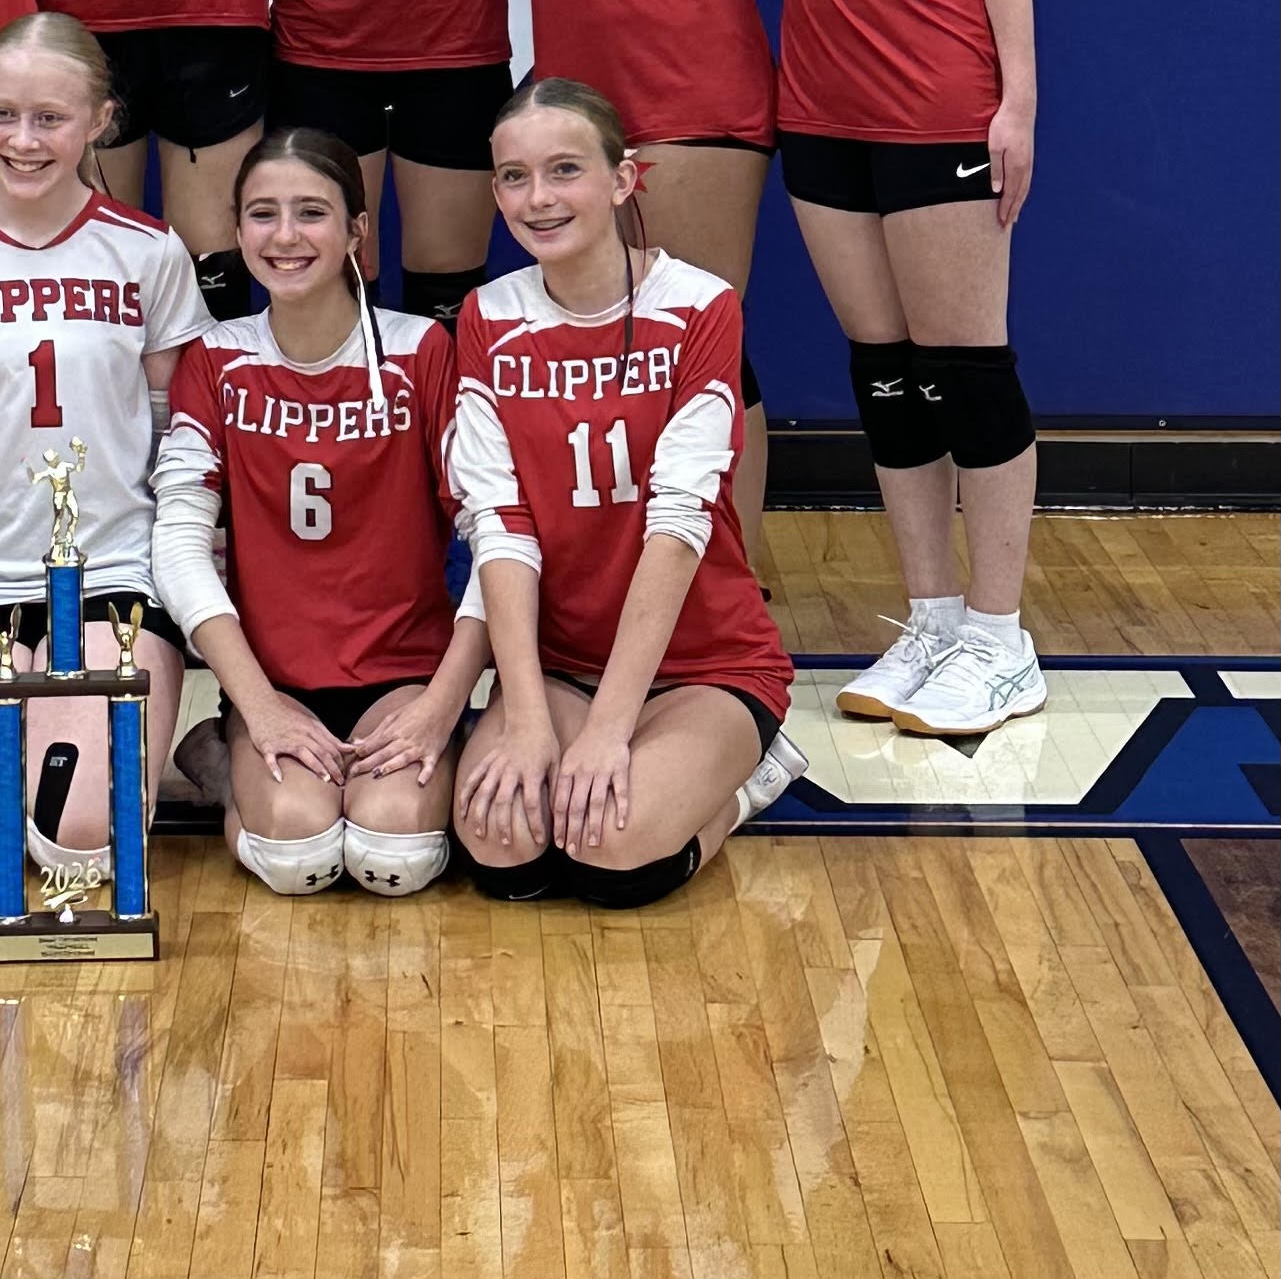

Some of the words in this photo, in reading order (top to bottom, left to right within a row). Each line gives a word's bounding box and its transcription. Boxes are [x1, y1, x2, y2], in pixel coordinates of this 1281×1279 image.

[28, 339, 63, 428] 1
[493, 343, 682, 401] CLIPPER
[290, 462, 332, 541] 6
[568, 419, 639, 507] 11
